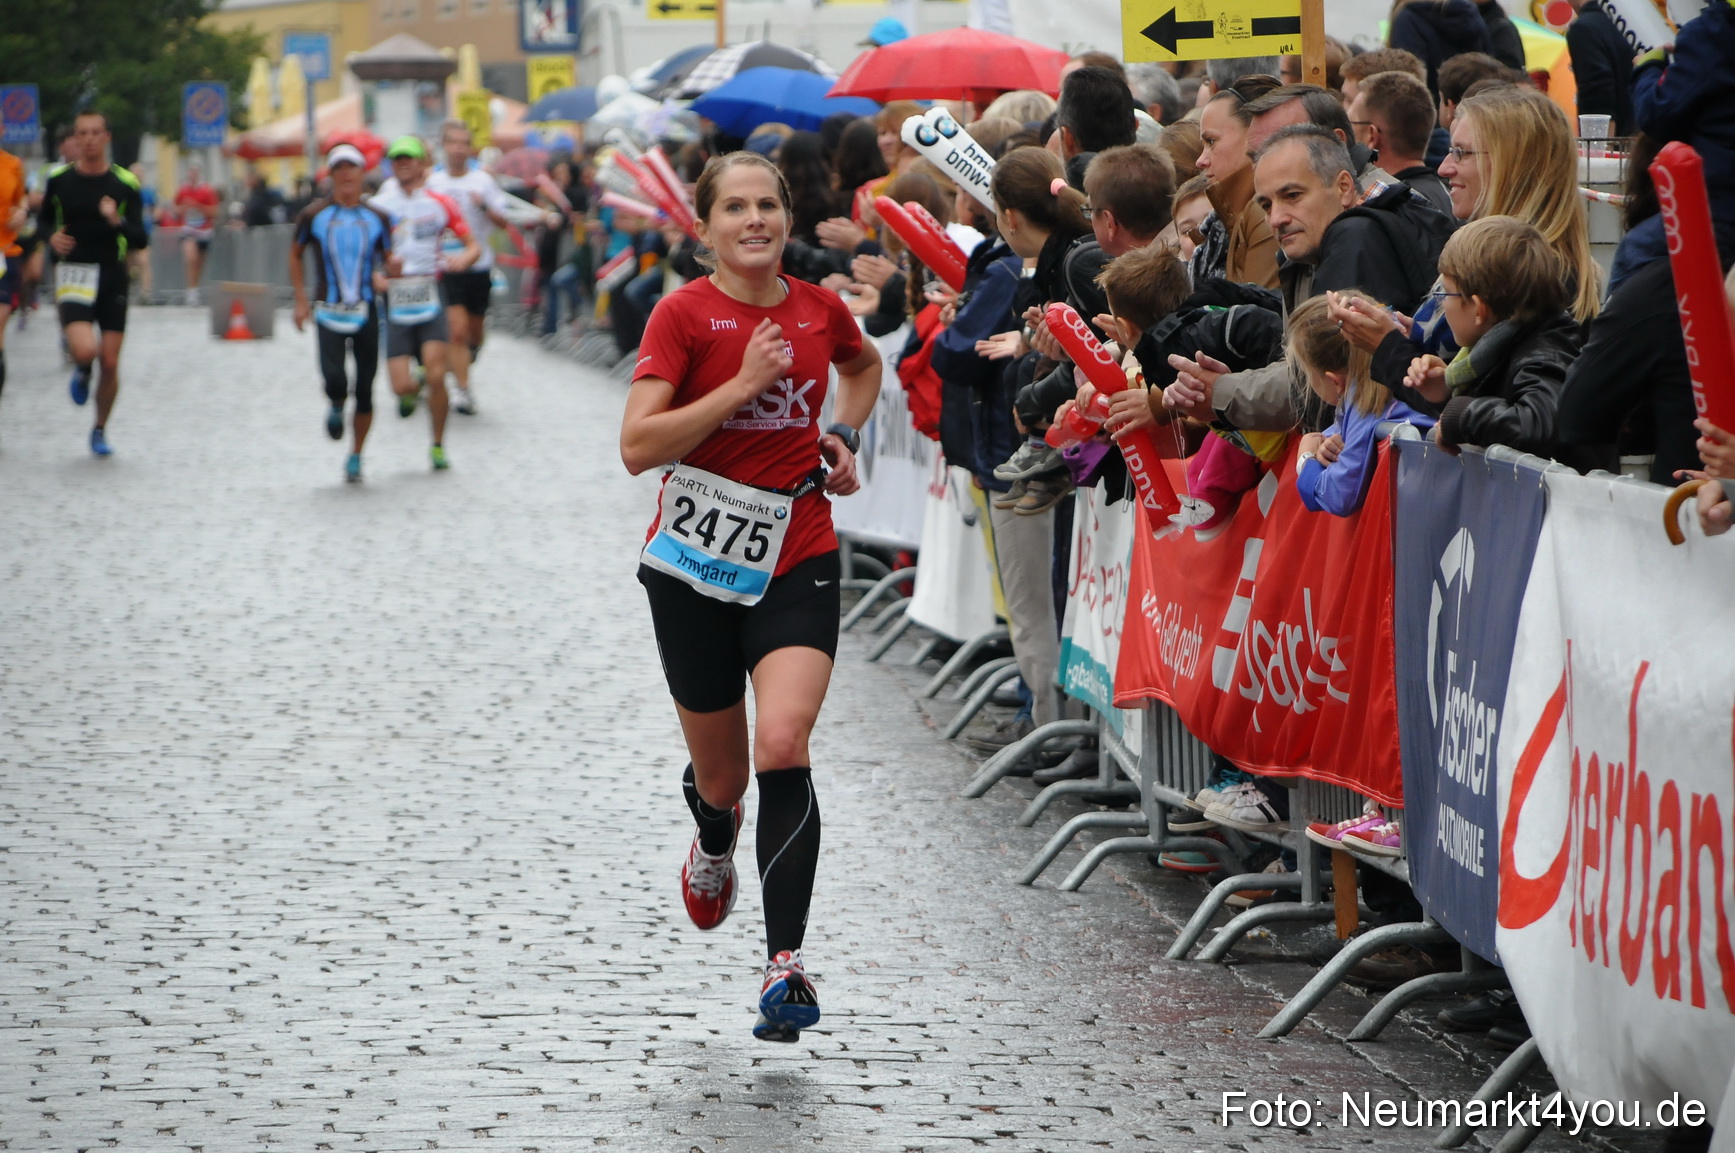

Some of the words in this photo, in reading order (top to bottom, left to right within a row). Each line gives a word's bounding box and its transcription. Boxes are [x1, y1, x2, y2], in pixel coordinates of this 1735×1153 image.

[710, 318, 738, 331] Irmi
[725, 420, 745, 429] Auto
[746, 420, 777, 429] Service
[670, 475, 709, 496] PARTL
[712, 489, 771, 516] Neumarkt
[1122, 444, 1163, 510] Audi
[671, 495, 773, 563] 2475
[676, 550, 739, 586] Irmgard
